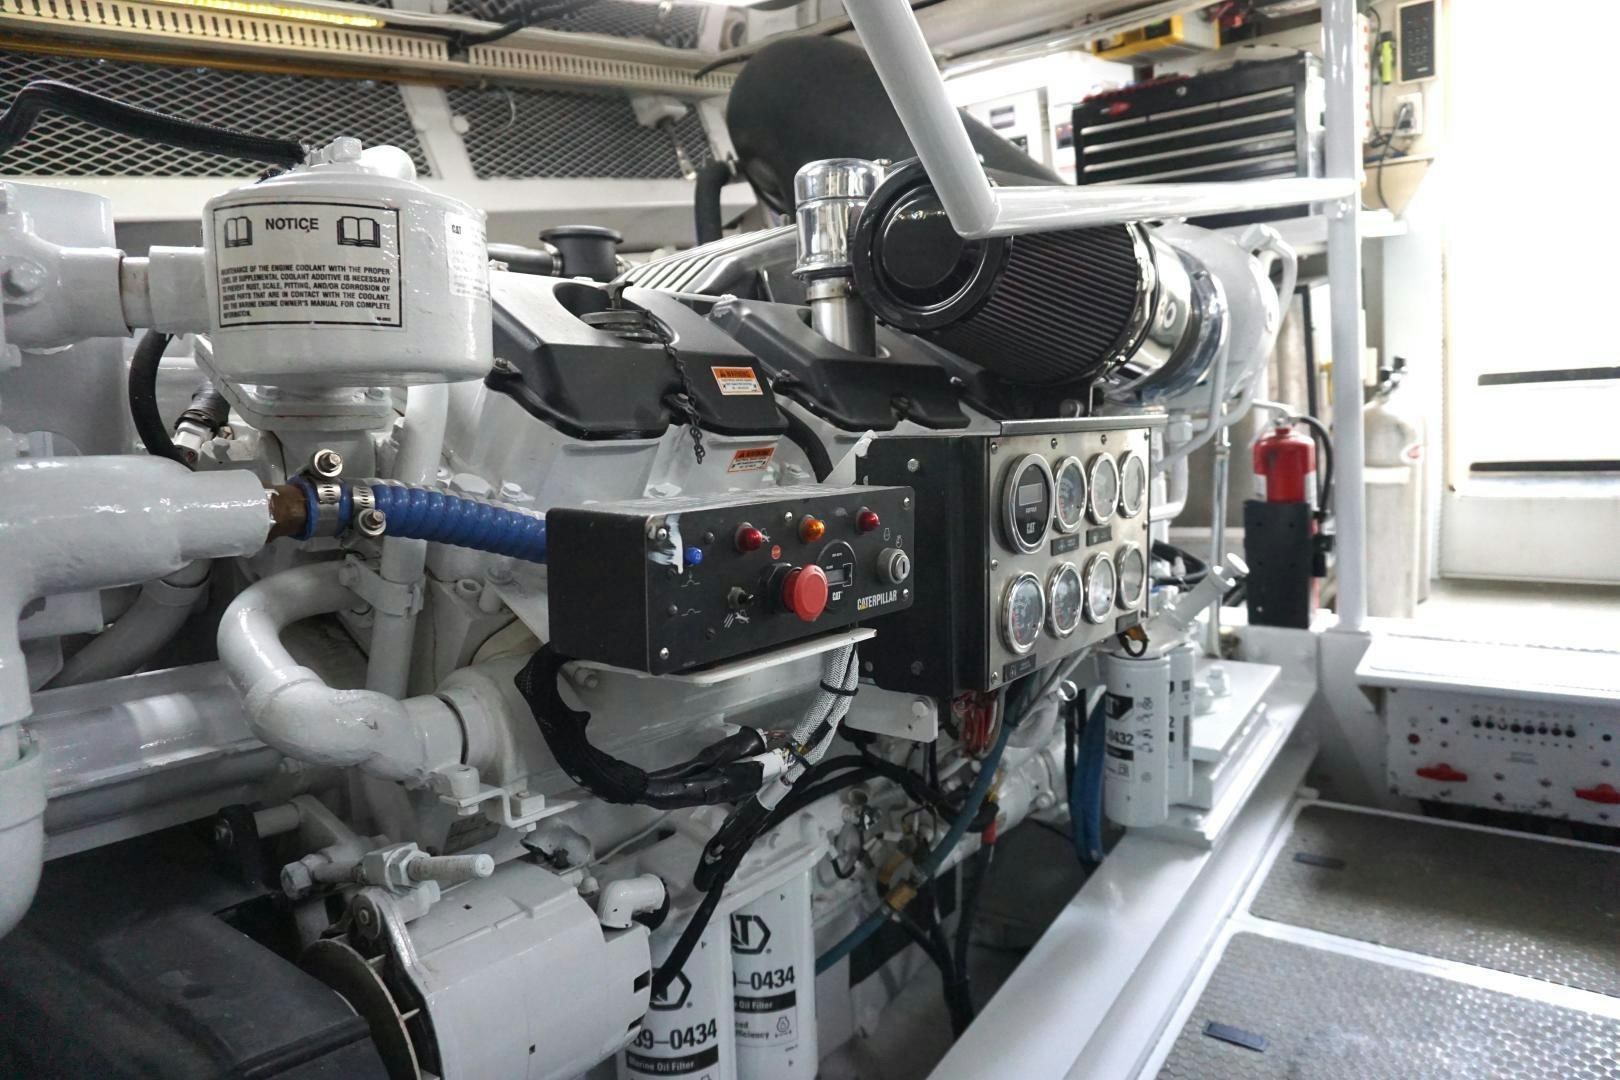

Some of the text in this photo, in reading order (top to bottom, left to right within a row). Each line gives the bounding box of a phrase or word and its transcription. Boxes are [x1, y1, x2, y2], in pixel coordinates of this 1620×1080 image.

[265, 217, 319, 230] NOTICE
[295, 264, 326, 272] COOLANT
[328, 264, 346, 272] WITH
[364, 266, 390, 275] PROPER
[239, 274, 279, 282] SUPPLEMENTAL
[311, 273, 341, 281] ADDITIVE
[352, 275, 390, 284] NECESSARY
[284, 282, 311, 290] PITTING,
[341, 283, 380, 291] CORROSION
[358, 292, 390, 301] COOLANT.
[356, 301, 390, 310] COMPLETE
[832, 591, 841, 601] CAT
[857, 590, 897, 611] CATERPILLAR
[733, 966, 795, 990] -0434
[752, 1000, 773, 1010] Filter
[656, 1062, 669, 1072] Oil
[671, 1061, 695, 1071] Filter
